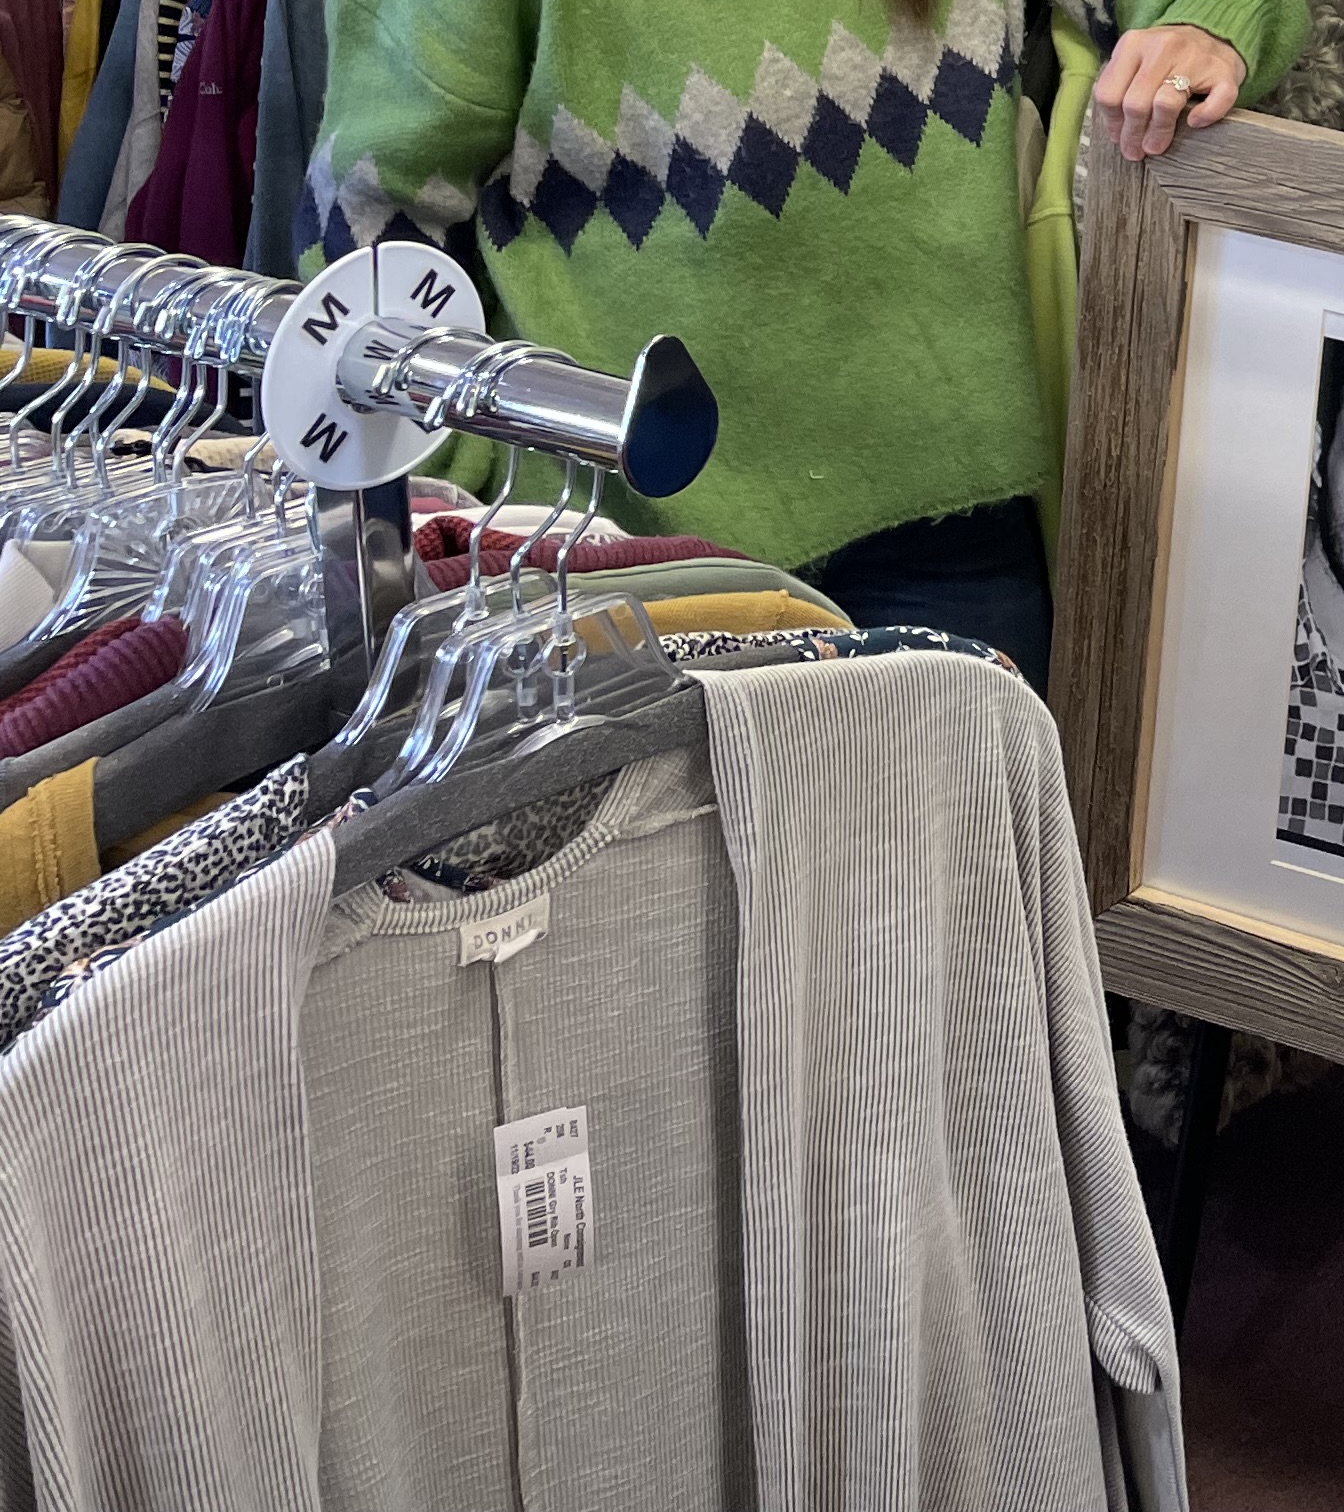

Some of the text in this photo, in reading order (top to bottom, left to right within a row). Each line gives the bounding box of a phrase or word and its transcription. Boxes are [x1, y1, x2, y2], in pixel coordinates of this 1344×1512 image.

[410, 268, 456, 318] M
[301, 291, 351, 346] M
[299, 412, 349, 464] M
[473, 913, 533, 950] DONNI
[572, 1175, 585, 1194] JLE
